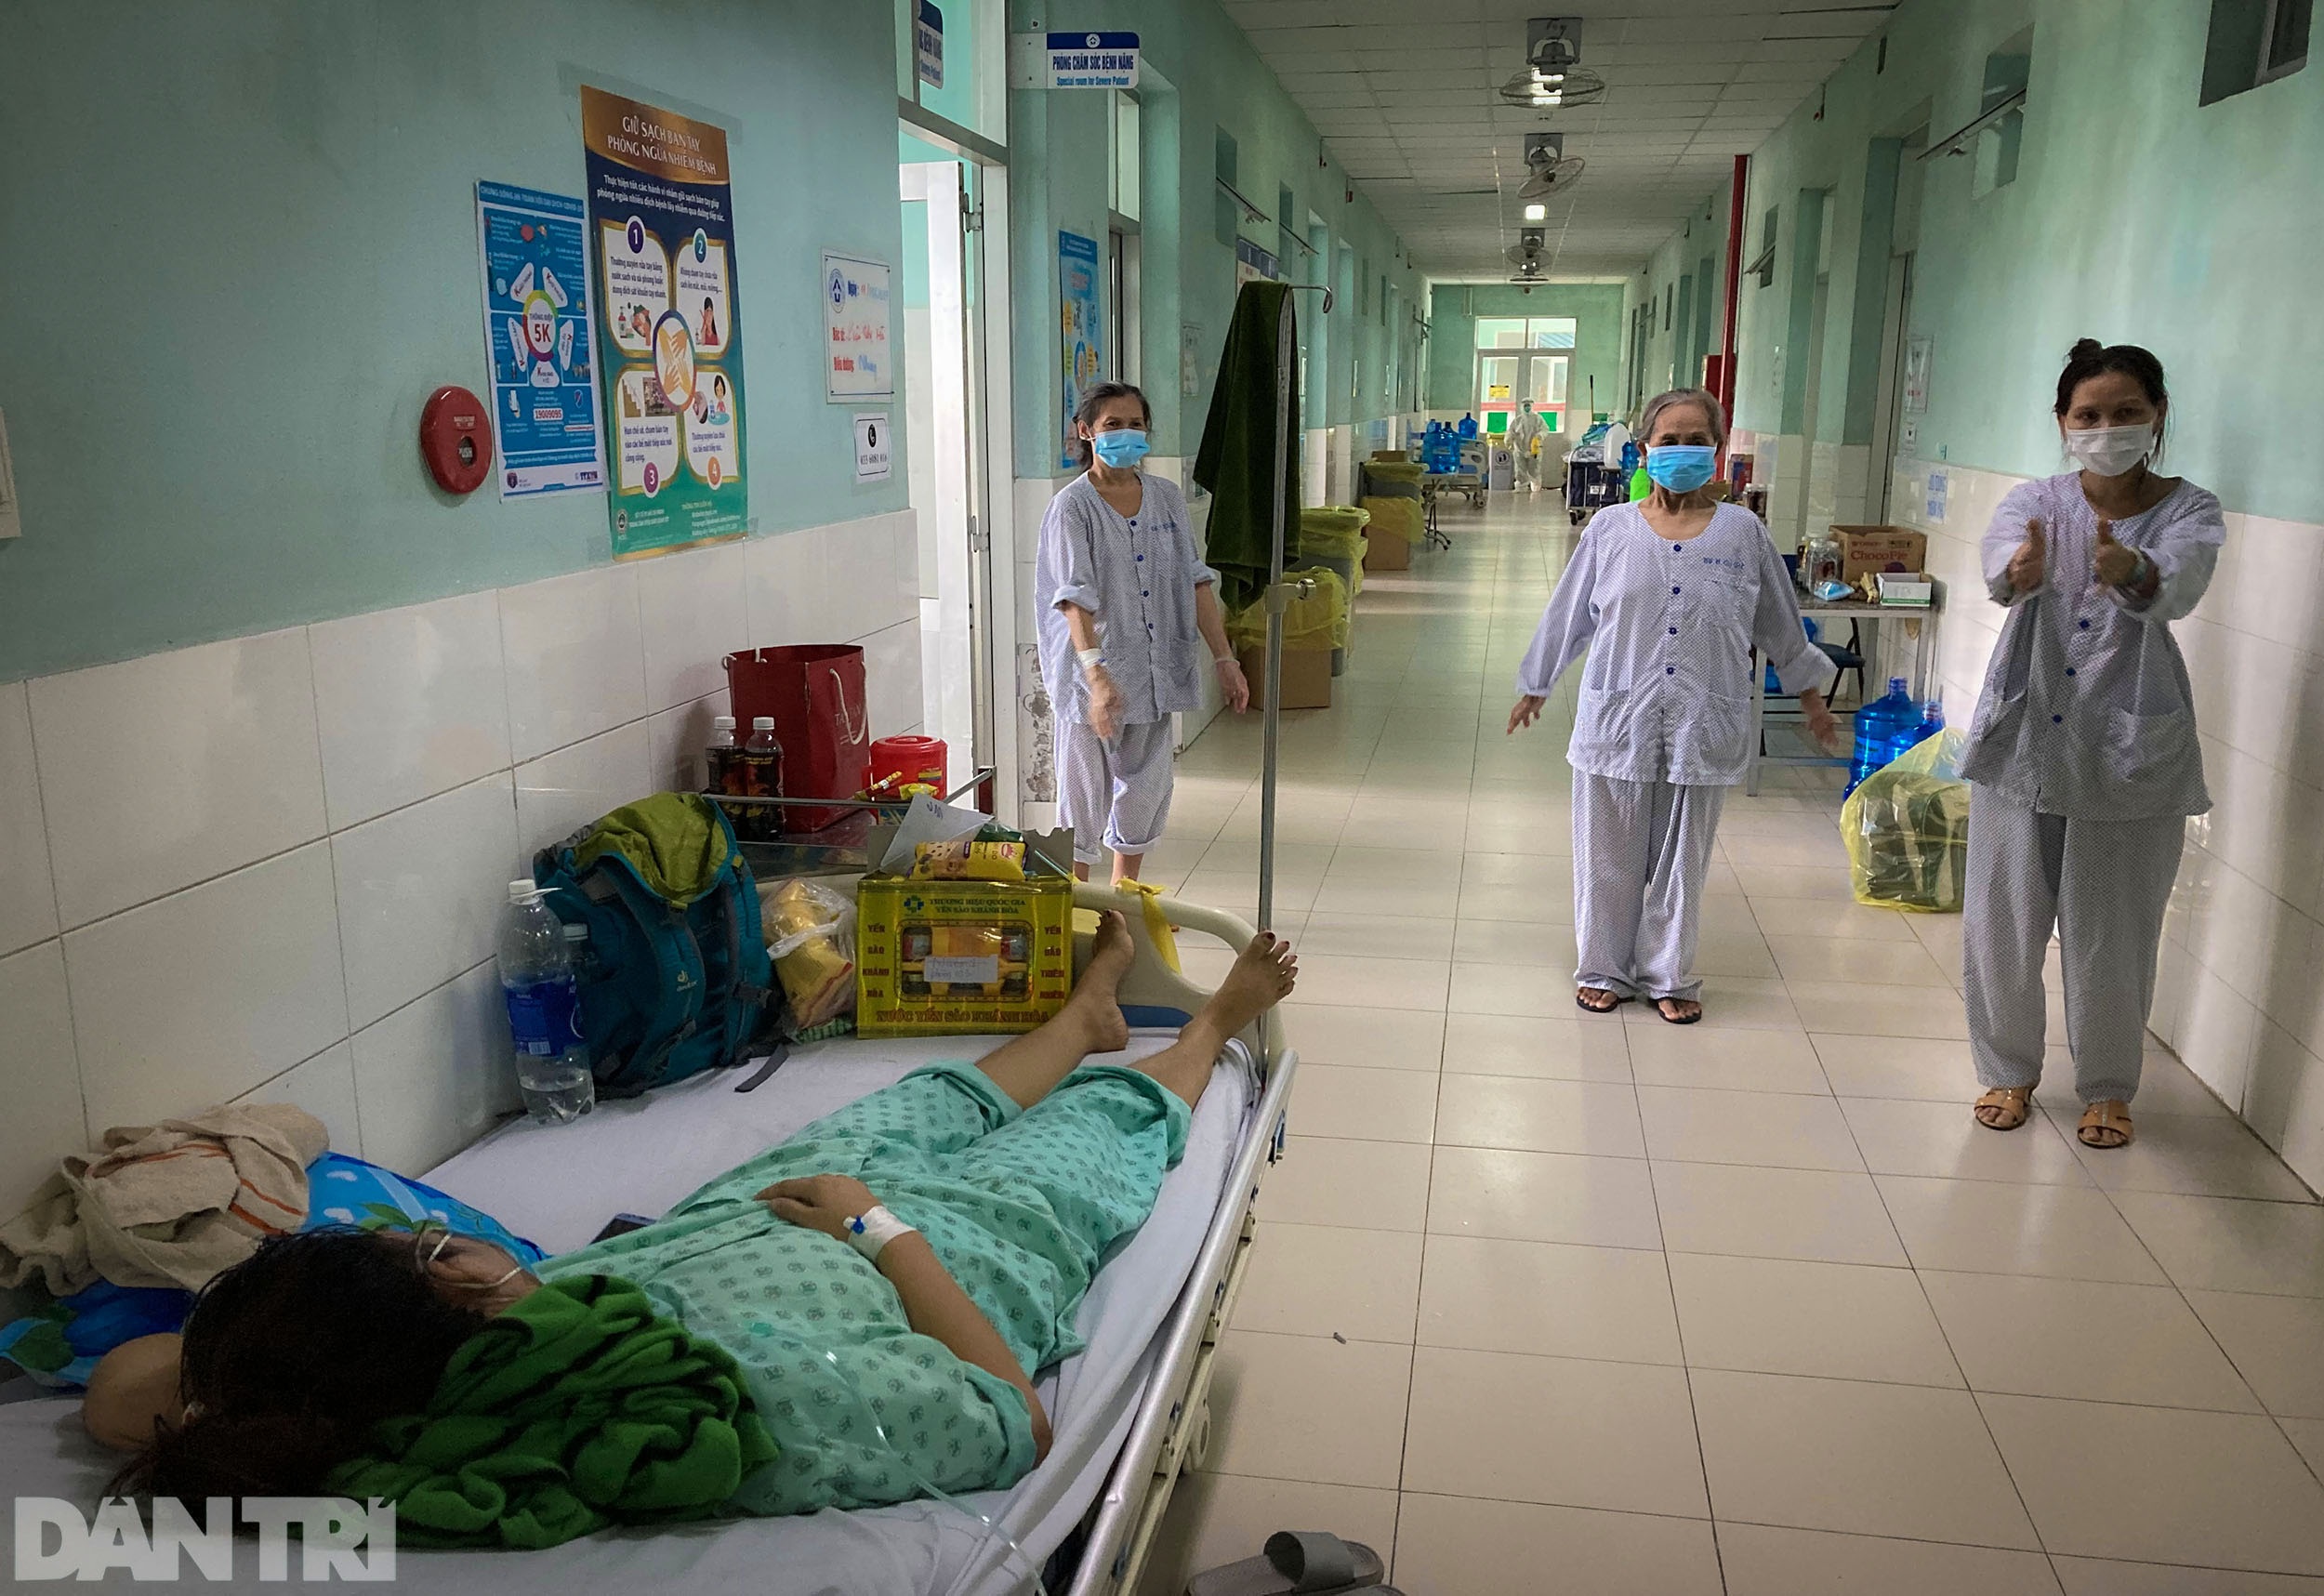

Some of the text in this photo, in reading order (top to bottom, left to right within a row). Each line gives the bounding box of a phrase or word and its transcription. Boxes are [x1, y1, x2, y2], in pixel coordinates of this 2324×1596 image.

[1053, 52, 1133, 73] PHÒNG CHĂM SÓC BỆNH NẶNG
[1057, 76, 1074, 86] Special
[1096, 76, 1111, 86] Severe
[1113, 76, 1129, 85] Patient
[641, 122, 667, 142] SẠCH
[687, 135, 701, 152] TAY
[608, 135, 640, 156] PHÒNG
[696, 156, 717, 176] BỆNH
[633, 229, 638, 244] 1
[698, 240, 704, 255] 2
[534, 323, 551, 343] 5K
[649, 469, 654, 484] 3
[712, 464, 717, 477] 4
[1851, 550, 1908, 561] Choco Pie
[867, 922, 885, 933] YẾN
[877, 1008, 915, 1022] NƯỚC
[917, 1006, 944, 1022] YẾN
[971, 1008, 1023, 1022] KHÁNH
